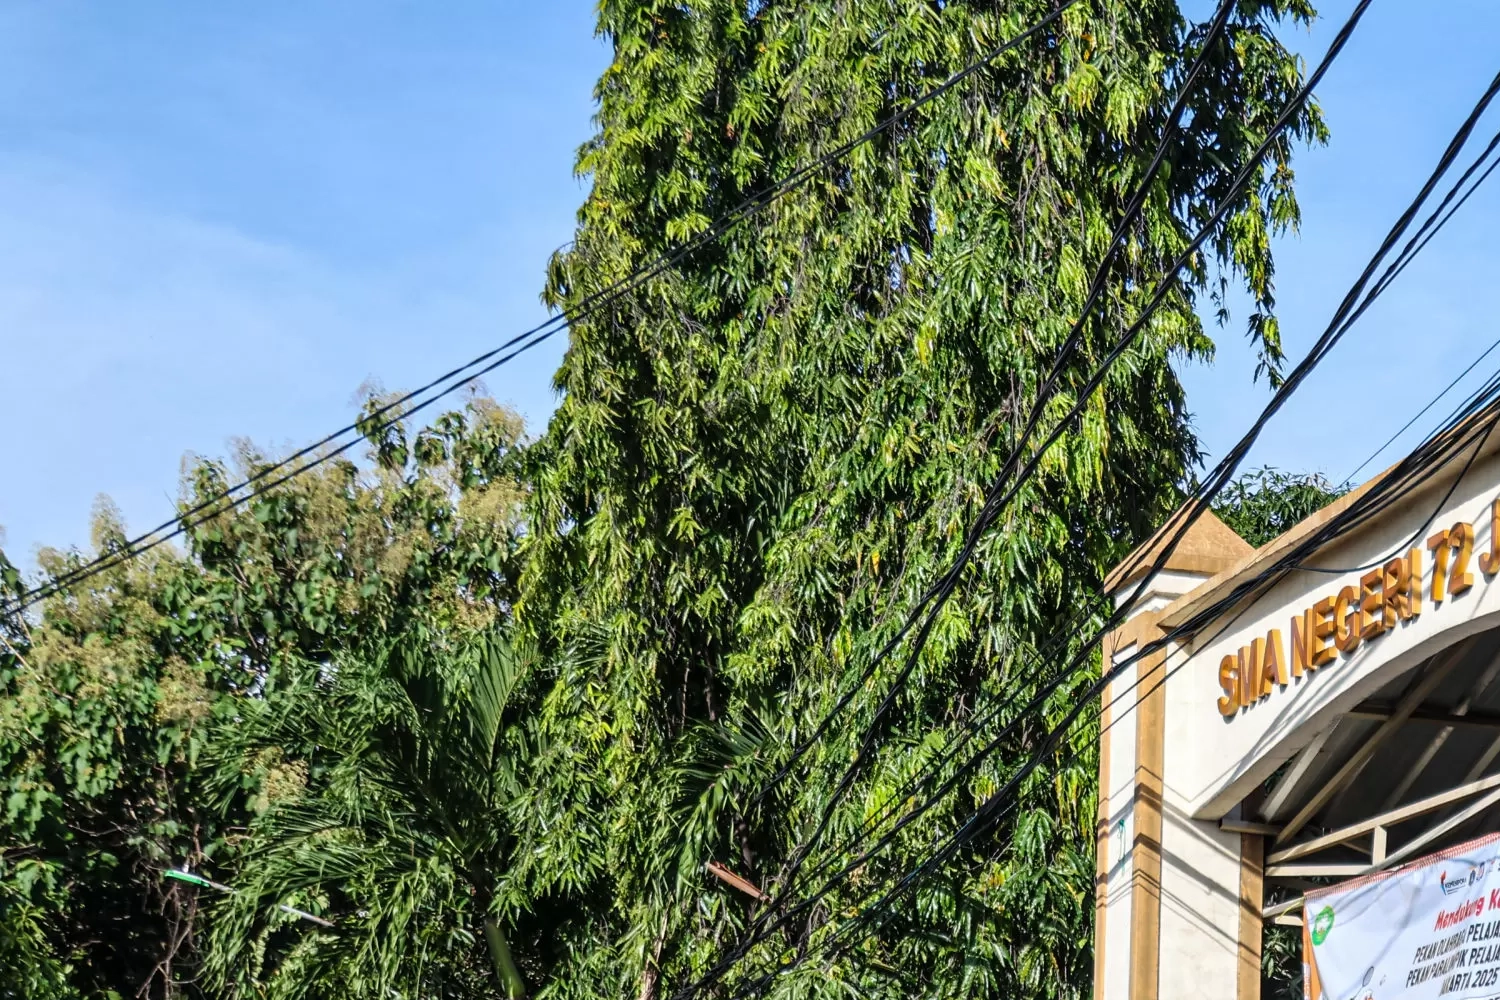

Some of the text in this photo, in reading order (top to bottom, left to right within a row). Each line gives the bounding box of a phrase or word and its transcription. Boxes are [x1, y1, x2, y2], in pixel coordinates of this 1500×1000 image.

[1218, 628, 1288, 717] SMA
[1290, 547, 1423, 679] NEGERI
[1427, 521, 1475, 602] 72
[1434, 896, 1485, 931] Mendukg
[1412, 941, 1439, 965] PEKAN
[1437, 928, 1467, 956] OLAHRAG
[1405, 964, 1431, 988] PEKAN
[1471, 967, 1500, 988] 2025
